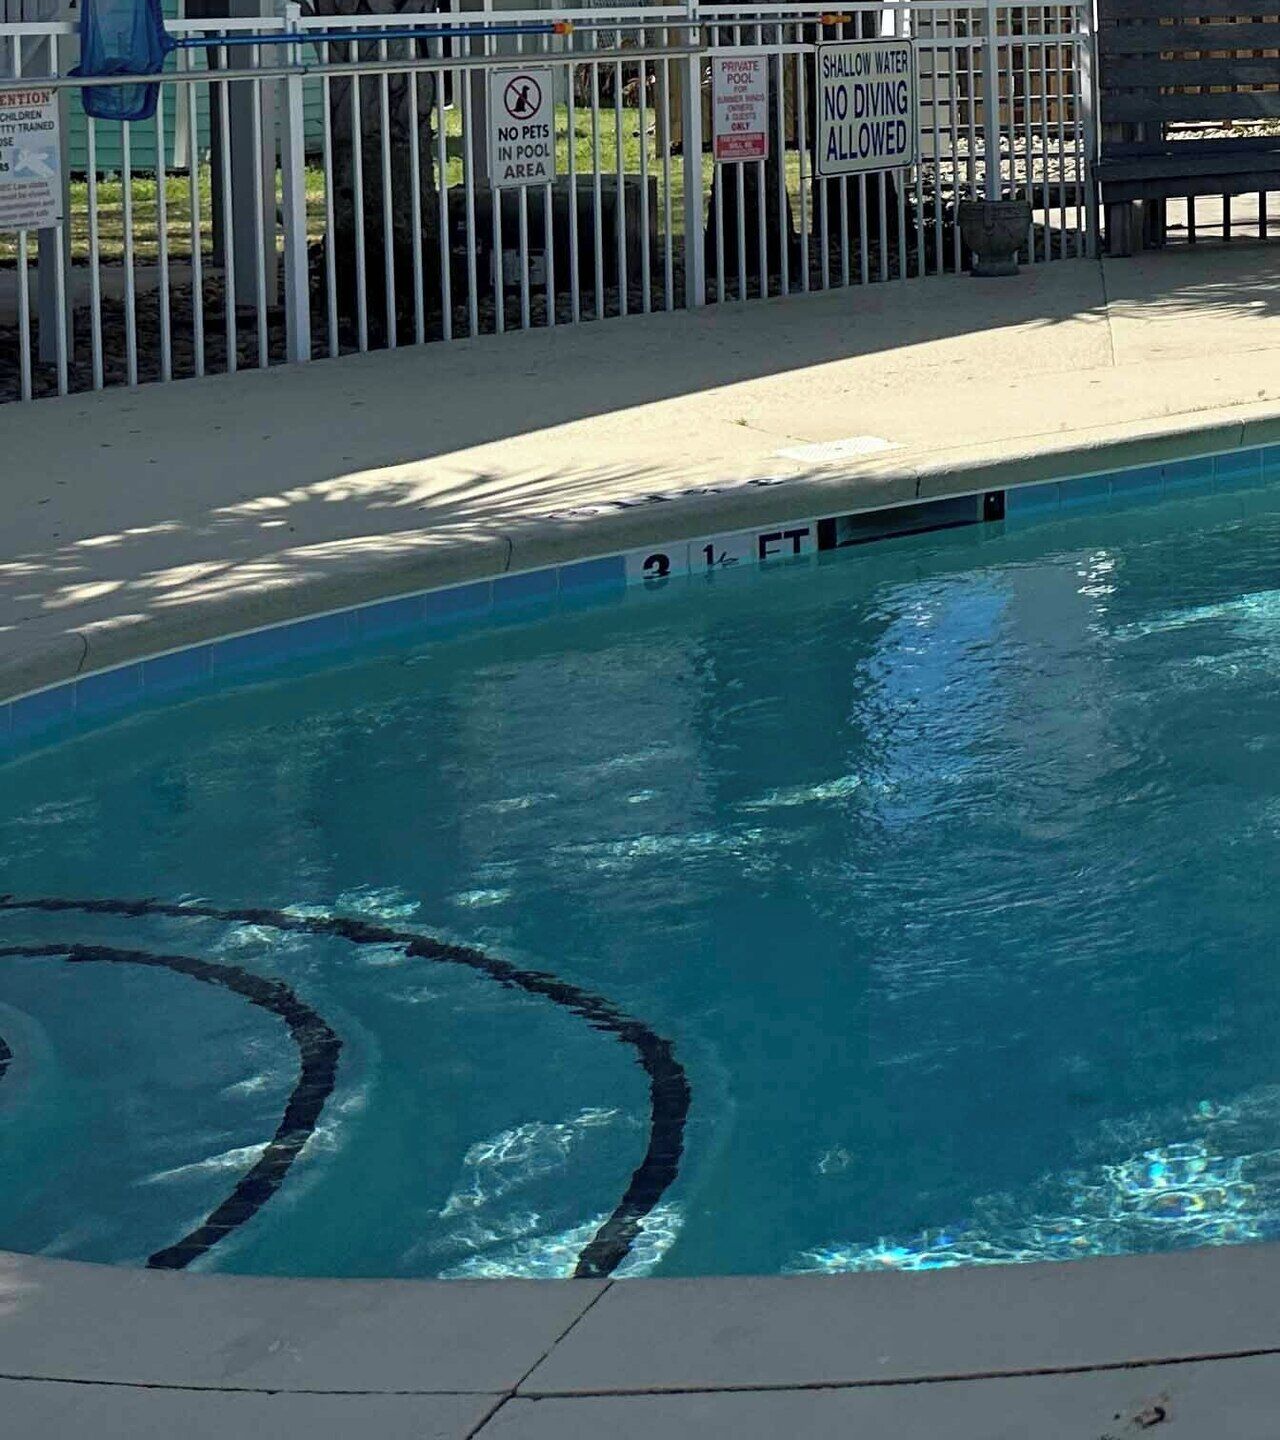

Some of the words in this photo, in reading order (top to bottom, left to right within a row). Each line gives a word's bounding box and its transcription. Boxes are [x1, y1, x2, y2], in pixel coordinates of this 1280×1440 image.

[722, 60, 759, 72] PRIVATE
[823, 52, 872, 78] SHALLOW
[875, 50, 908, 74] WATER
[727, 72, 754, 85] POOL
[825, 85, 848, 121] NO
[854, 80, 908, 119] DIVING
[18, 121, 55, 133] TRAINED
[498, 126, 519, 141] NO
[522, 124, 549, 139] PETS
[731, 122, 750, 131] ONLY
[827, 120, 907, 162] ALLOWED
[498, 146, 512, 161] IN
[516, 143, 550, 160] POOL
[504, 162, 546, 179] AREA
[759, 528, 809, 560] FT
